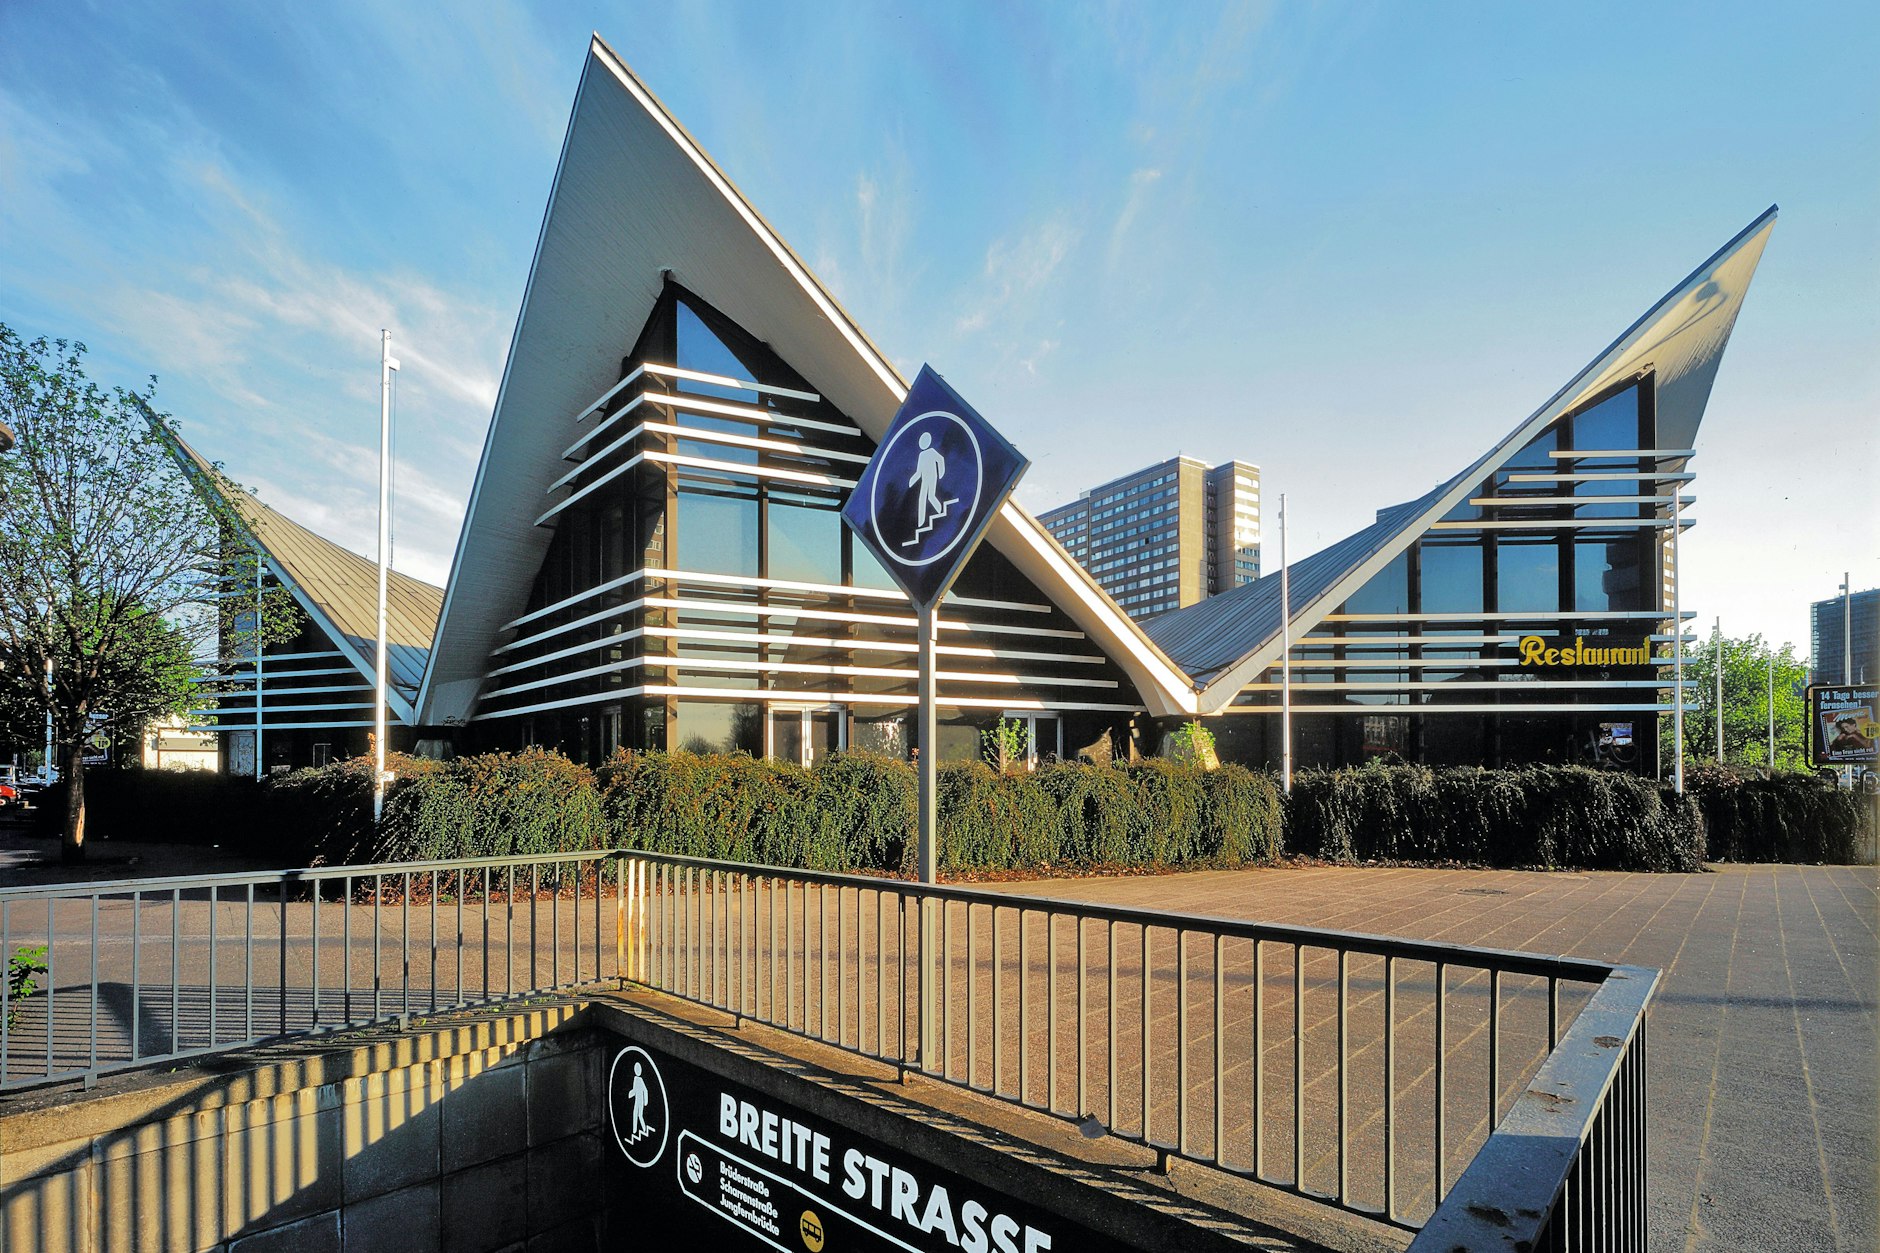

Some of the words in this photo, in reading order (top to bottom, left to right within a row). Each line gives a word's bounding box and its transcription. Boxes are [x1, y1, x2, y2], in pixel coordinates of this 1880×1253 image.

[1519, 635, 1651, 666] Restaurant
[1820, 691, 1830, 700] 14
[1832, 691, 1850, 701] Tage
[1853, 690, 1878, 699] besser
[719, 1092, 831, 1185] BREITE
[719, 1160, 770, 1198] Brüderstraße
[719, 1176, 779, 1219] Scharrenstraße
[719, 1193, 780, 1236] Jungfernbrücke
